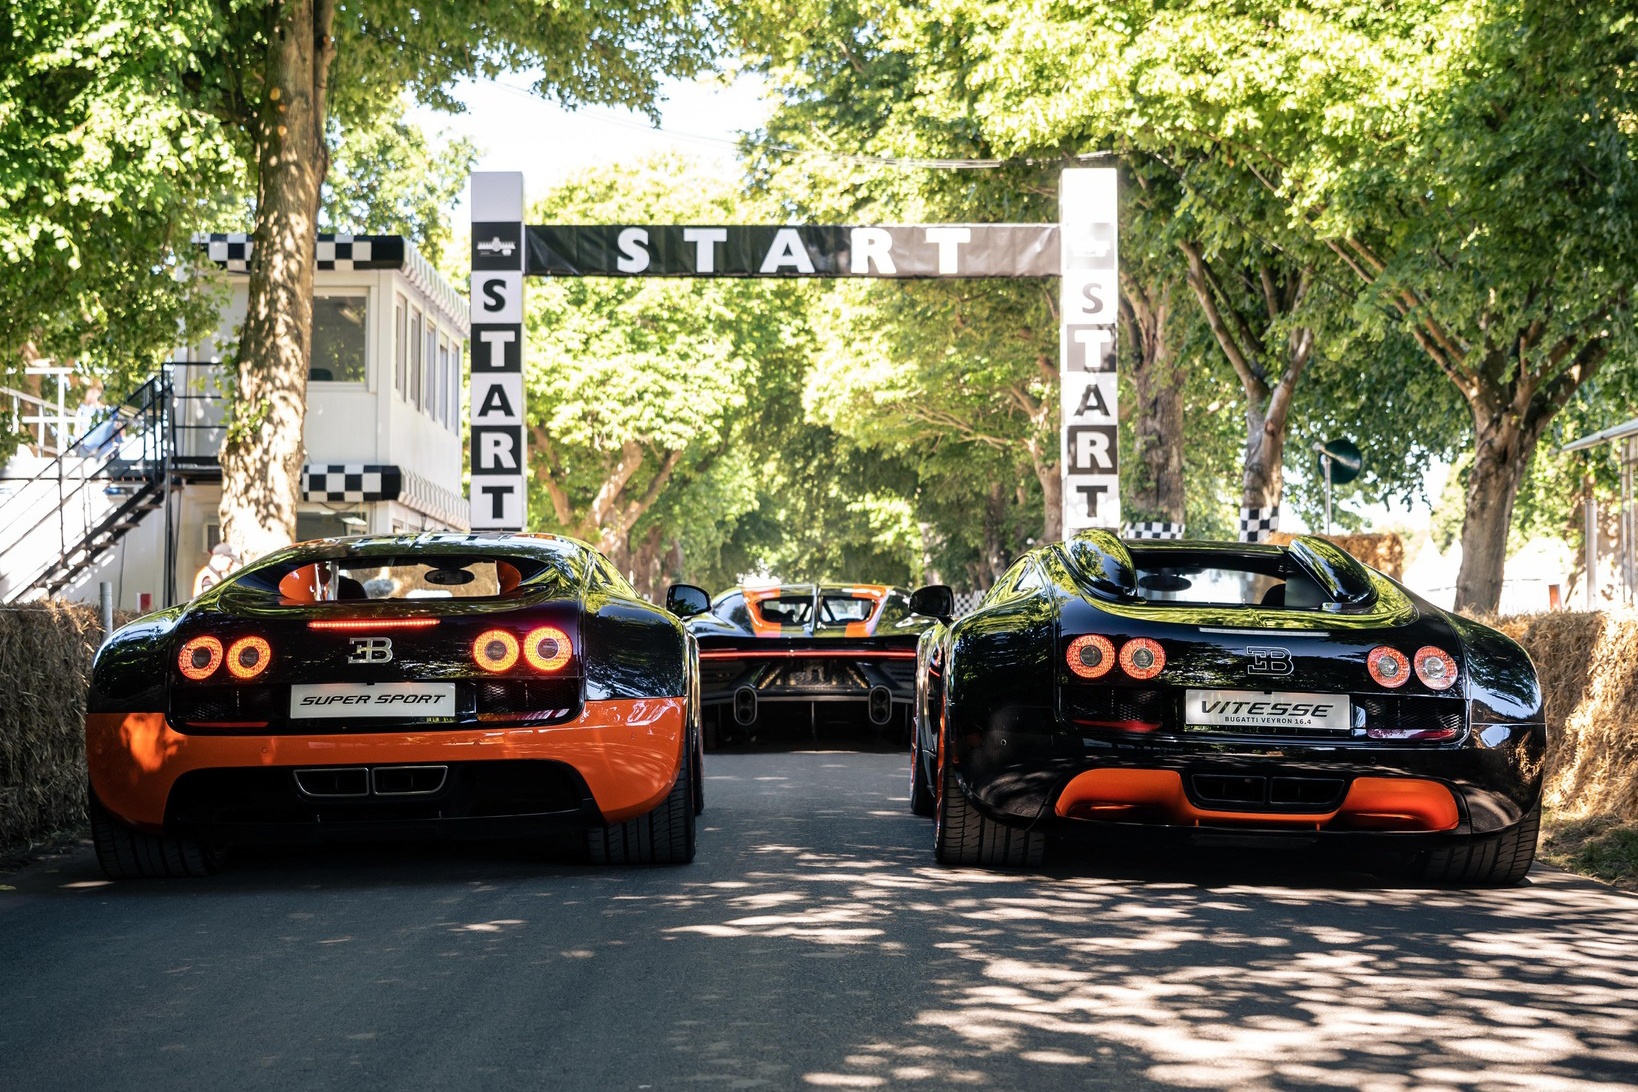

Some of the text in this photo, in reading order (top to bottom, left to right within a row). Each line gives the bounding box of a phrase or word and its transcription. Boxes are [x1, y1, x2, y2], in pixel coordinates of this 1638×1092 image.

[617, 227, 971, 274] START
[478, 278, 517, 520] START
[1073, 282, 1113, 518] START
[300, 694, 446, 706] SUPER SPORT
[1201, 700, 1333, 717] VITESSE
[1224, 716, 1312, 726] BUGATTI VEYRON 16.4
